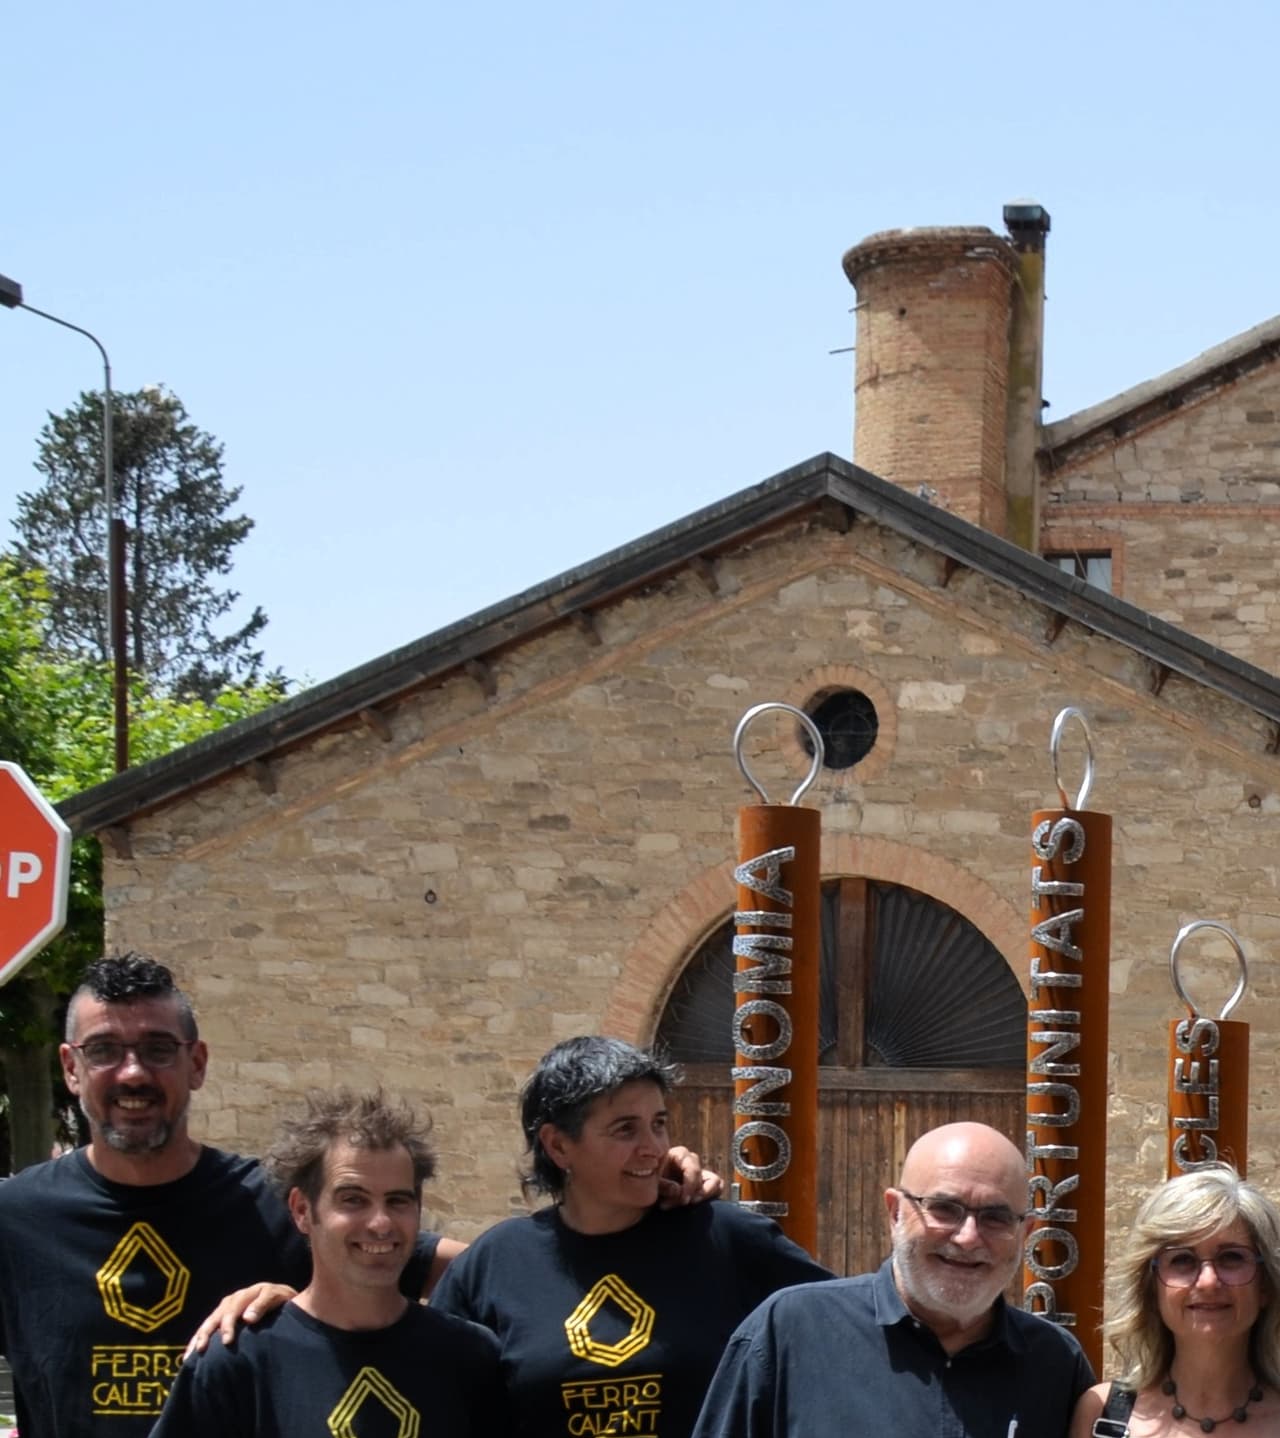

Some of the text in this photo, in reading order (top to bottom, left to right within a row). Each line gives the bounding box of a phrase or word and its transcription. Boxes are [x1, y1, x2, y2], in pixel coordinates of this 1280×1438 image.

[1173, 1017, 1220, 1173] CLES
[562, 1381, 661, 1409] FERRO
[568, 1409, 661, 1436] CALENT
